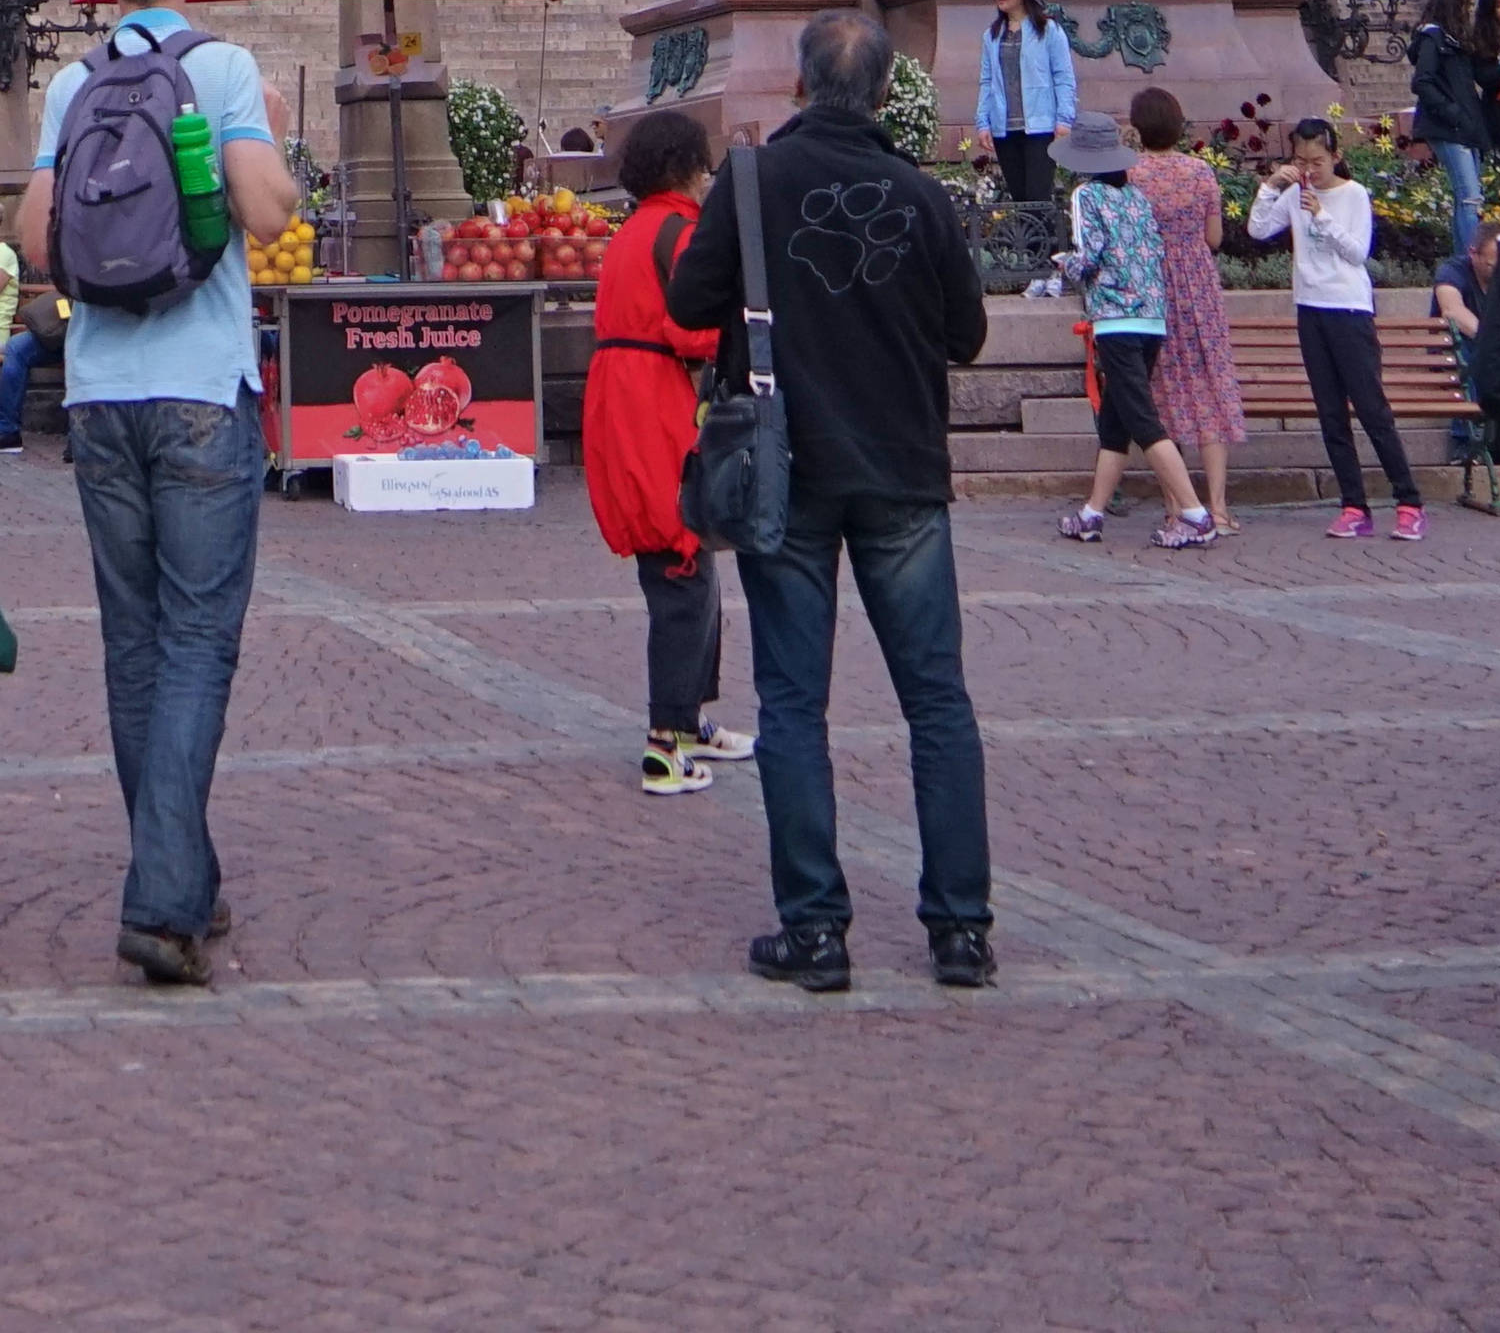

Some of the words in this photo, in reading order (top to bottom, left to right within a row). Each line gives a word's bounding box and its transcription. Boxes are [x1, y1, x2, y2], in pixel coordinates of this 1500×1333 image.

[332, 302, 493, 326] Pomegranate
[346, 325, 416, 349] Fresh
[419, 325, 482, 348] Juice
